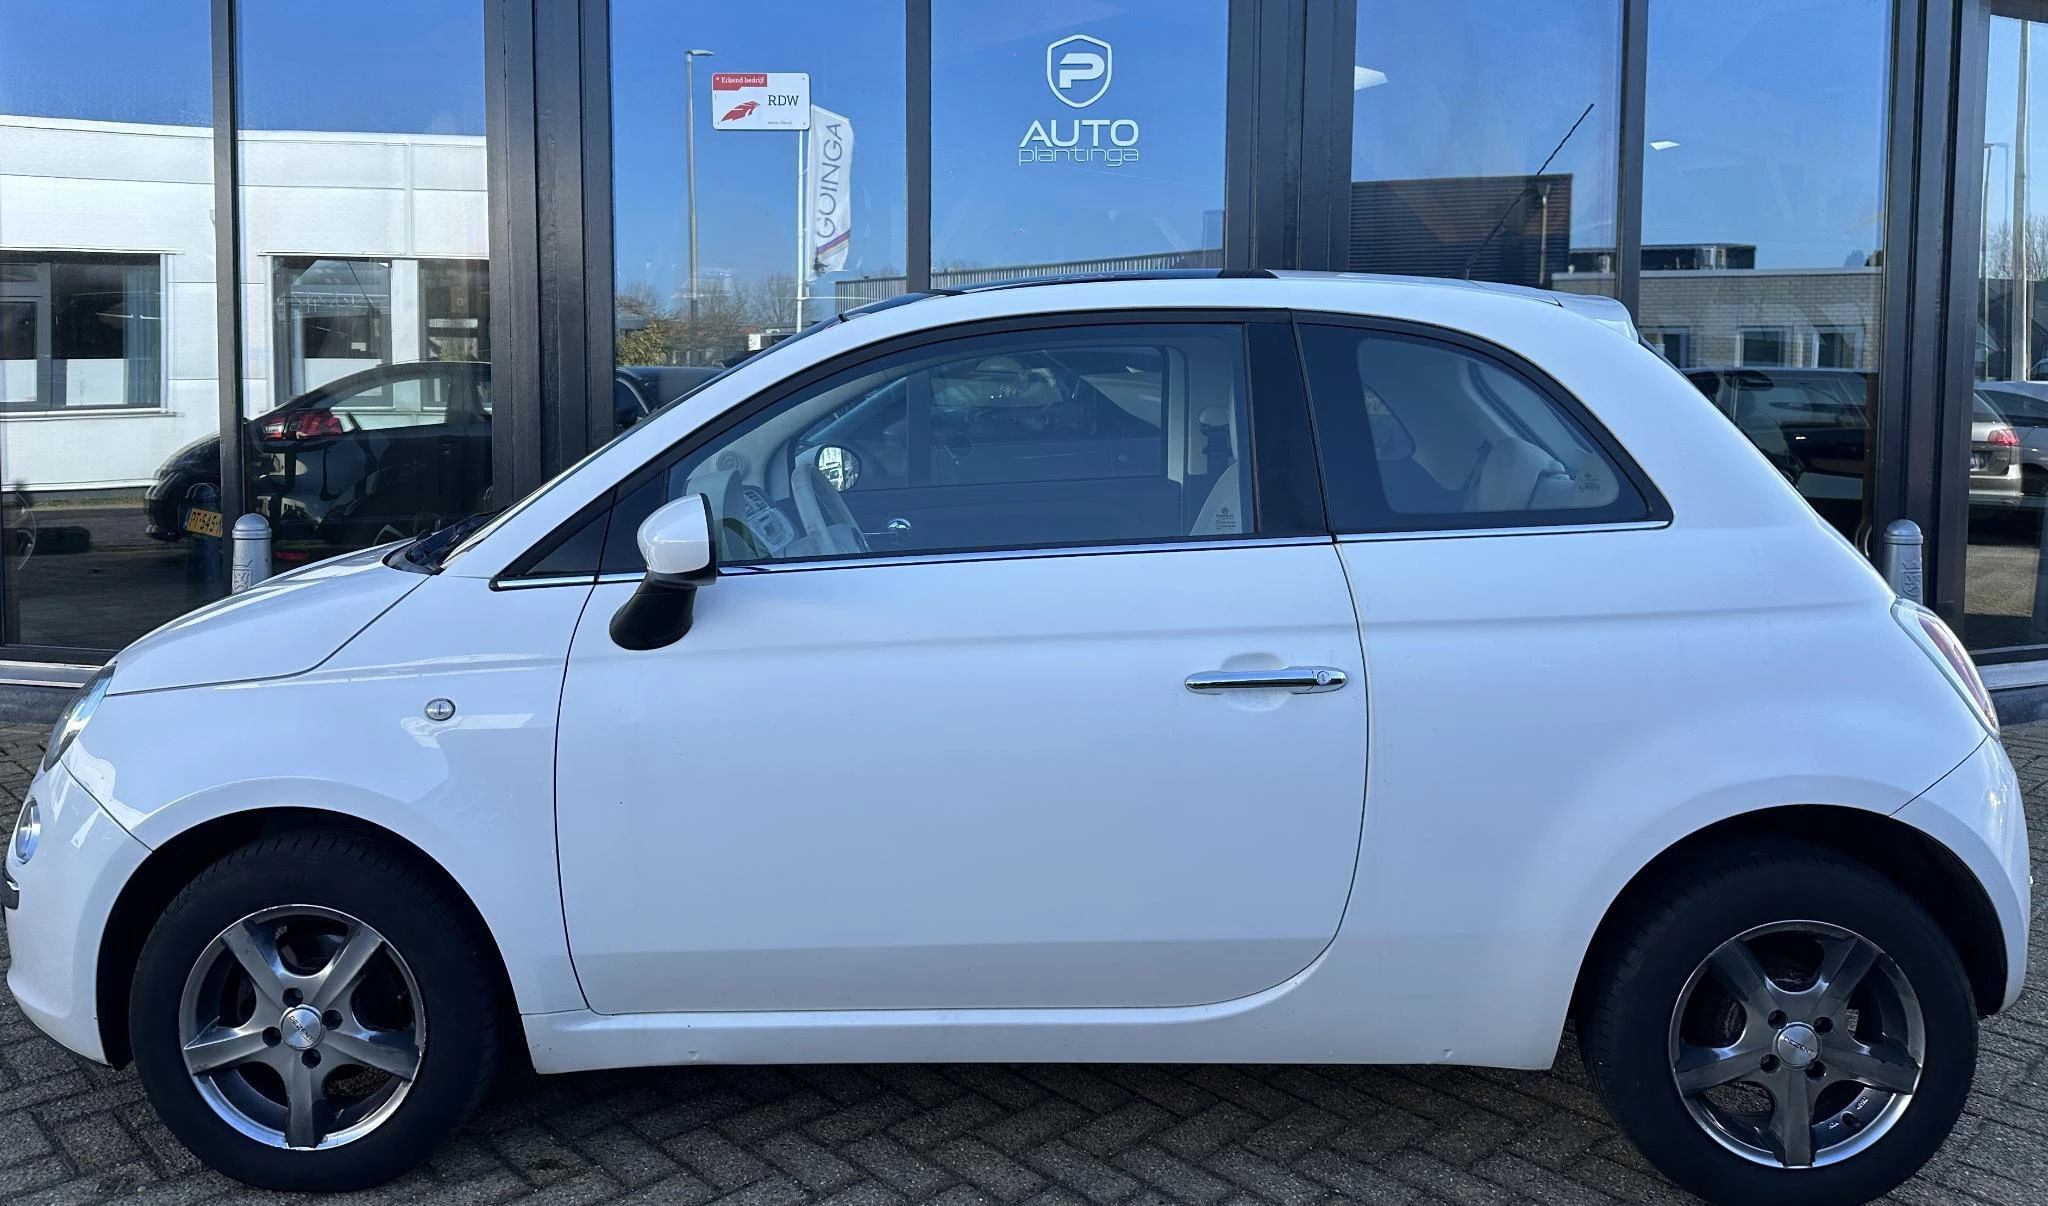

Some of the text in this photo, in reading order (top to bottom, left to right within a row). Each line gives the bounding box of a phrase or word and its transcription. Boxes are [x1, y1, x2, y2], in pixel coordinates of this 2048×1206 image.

[721, 76, 765, 85] Erkend bedrijf
[767, 94, 799, 106] RDW
[1019, 119, 1139, 147] AUTO
[1018, 146, 1139, 167] plantinga
[816, 123, 843, 239] GOINGA
